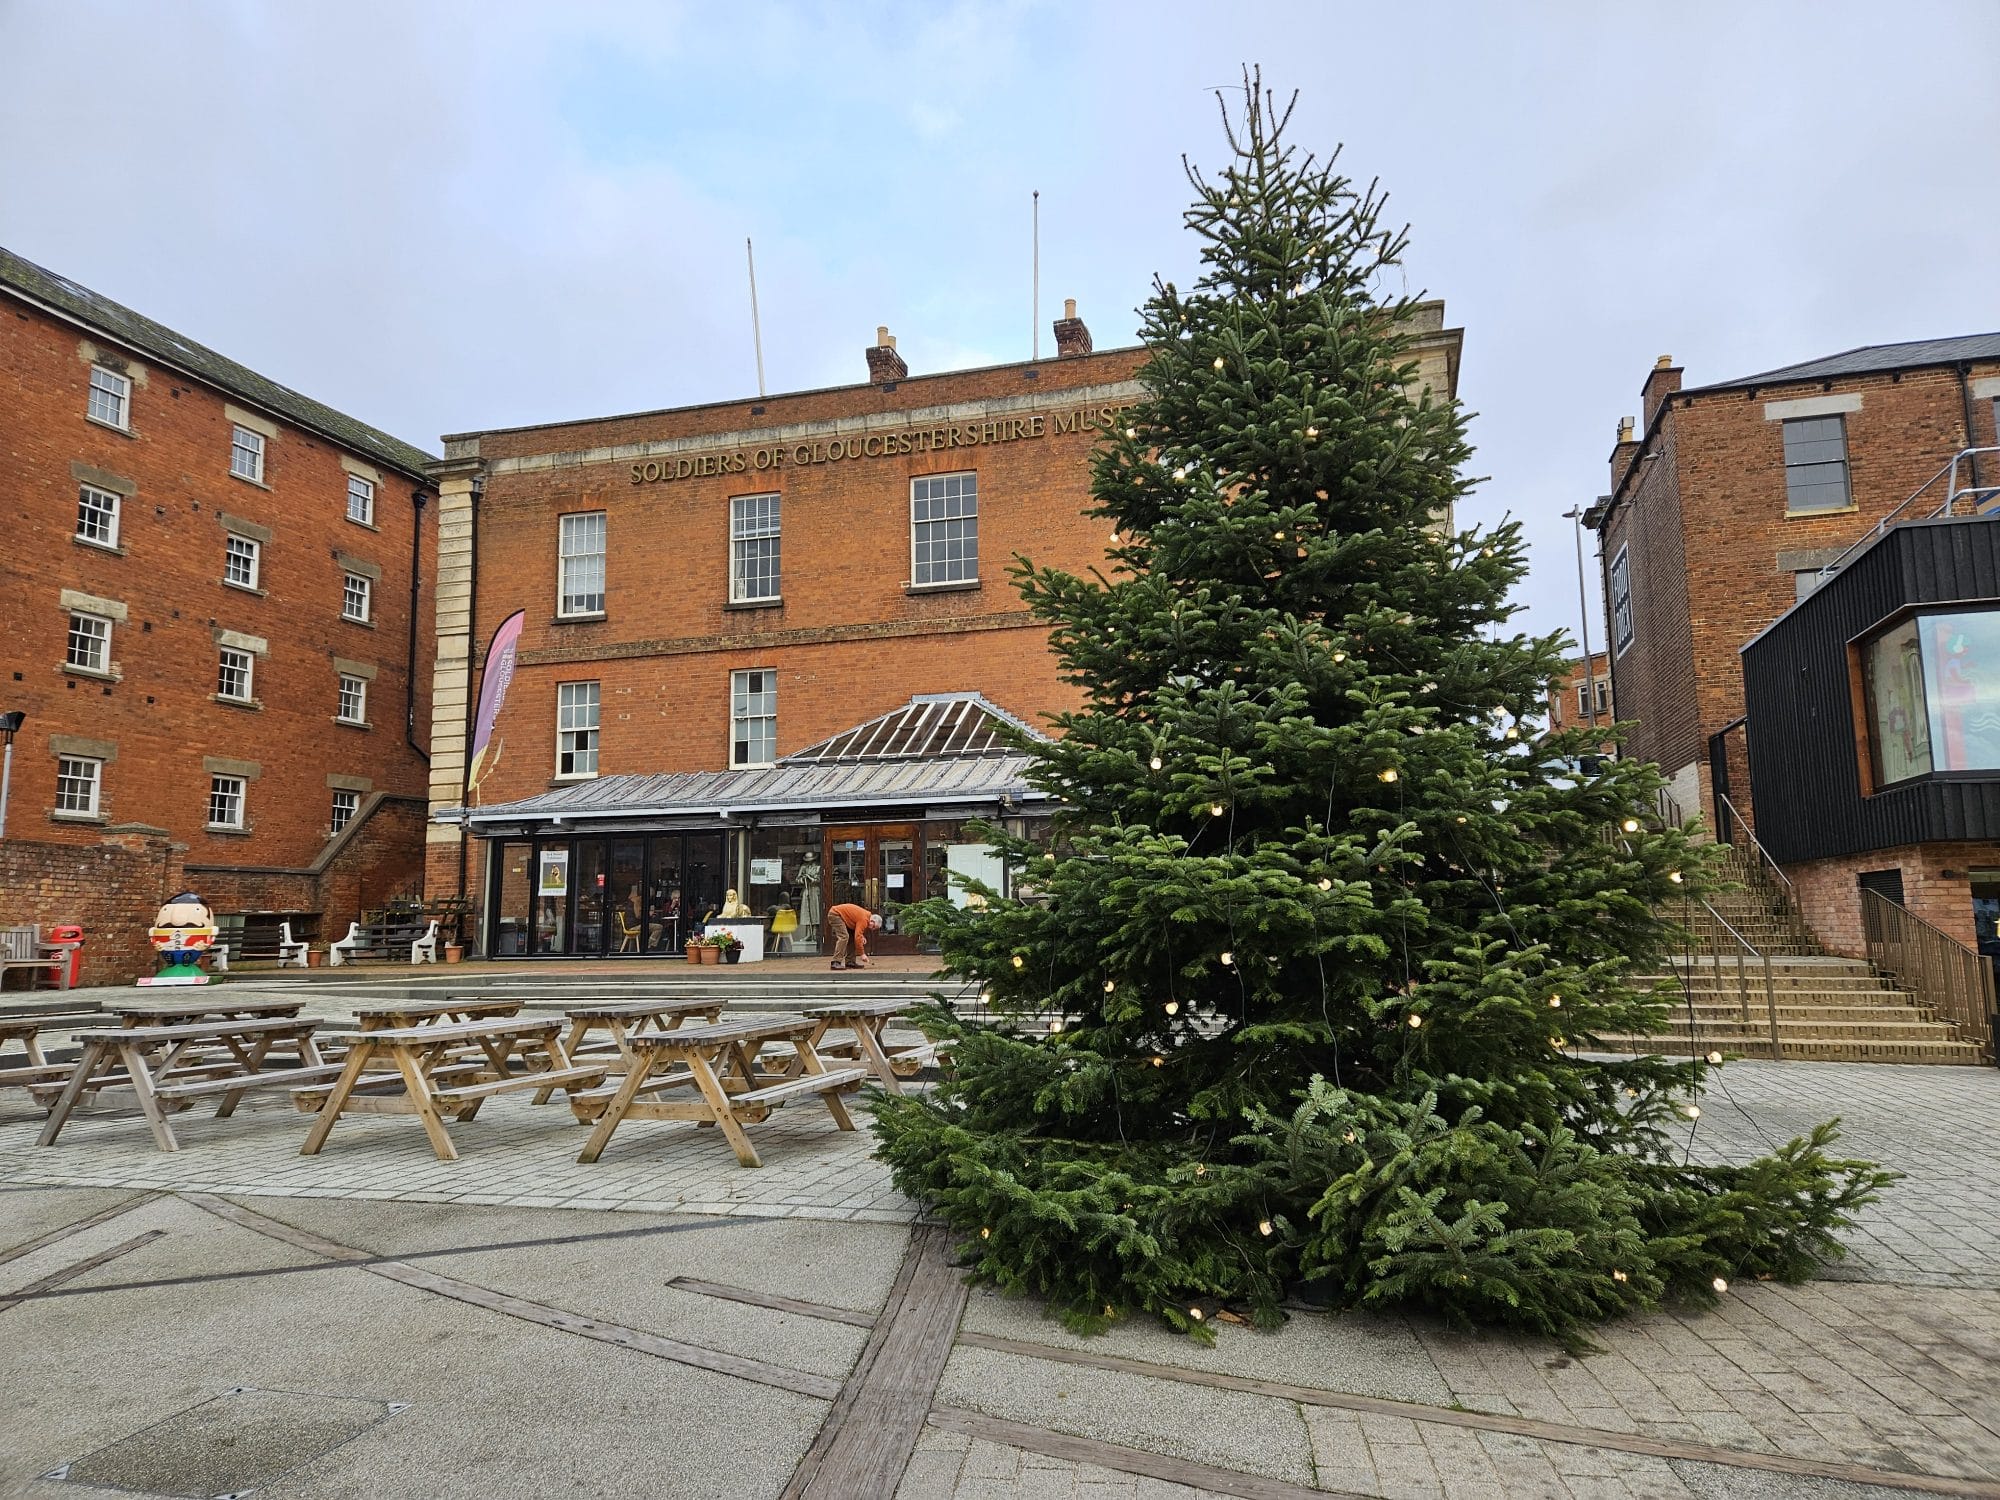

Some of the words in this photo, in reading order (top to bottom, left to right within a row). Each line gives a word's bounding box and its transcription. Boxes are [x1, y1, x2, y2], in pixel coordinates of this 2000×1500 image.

[630, 452, 746, 485] SOLDIERS
[753, 448, 785, 470] OF
[792, 415, 1046, 466] GLOUCESTERSHIRE
[1613, 557, 1628, 607] FOOD
[1616, 597, 1632, 646] DOCK
